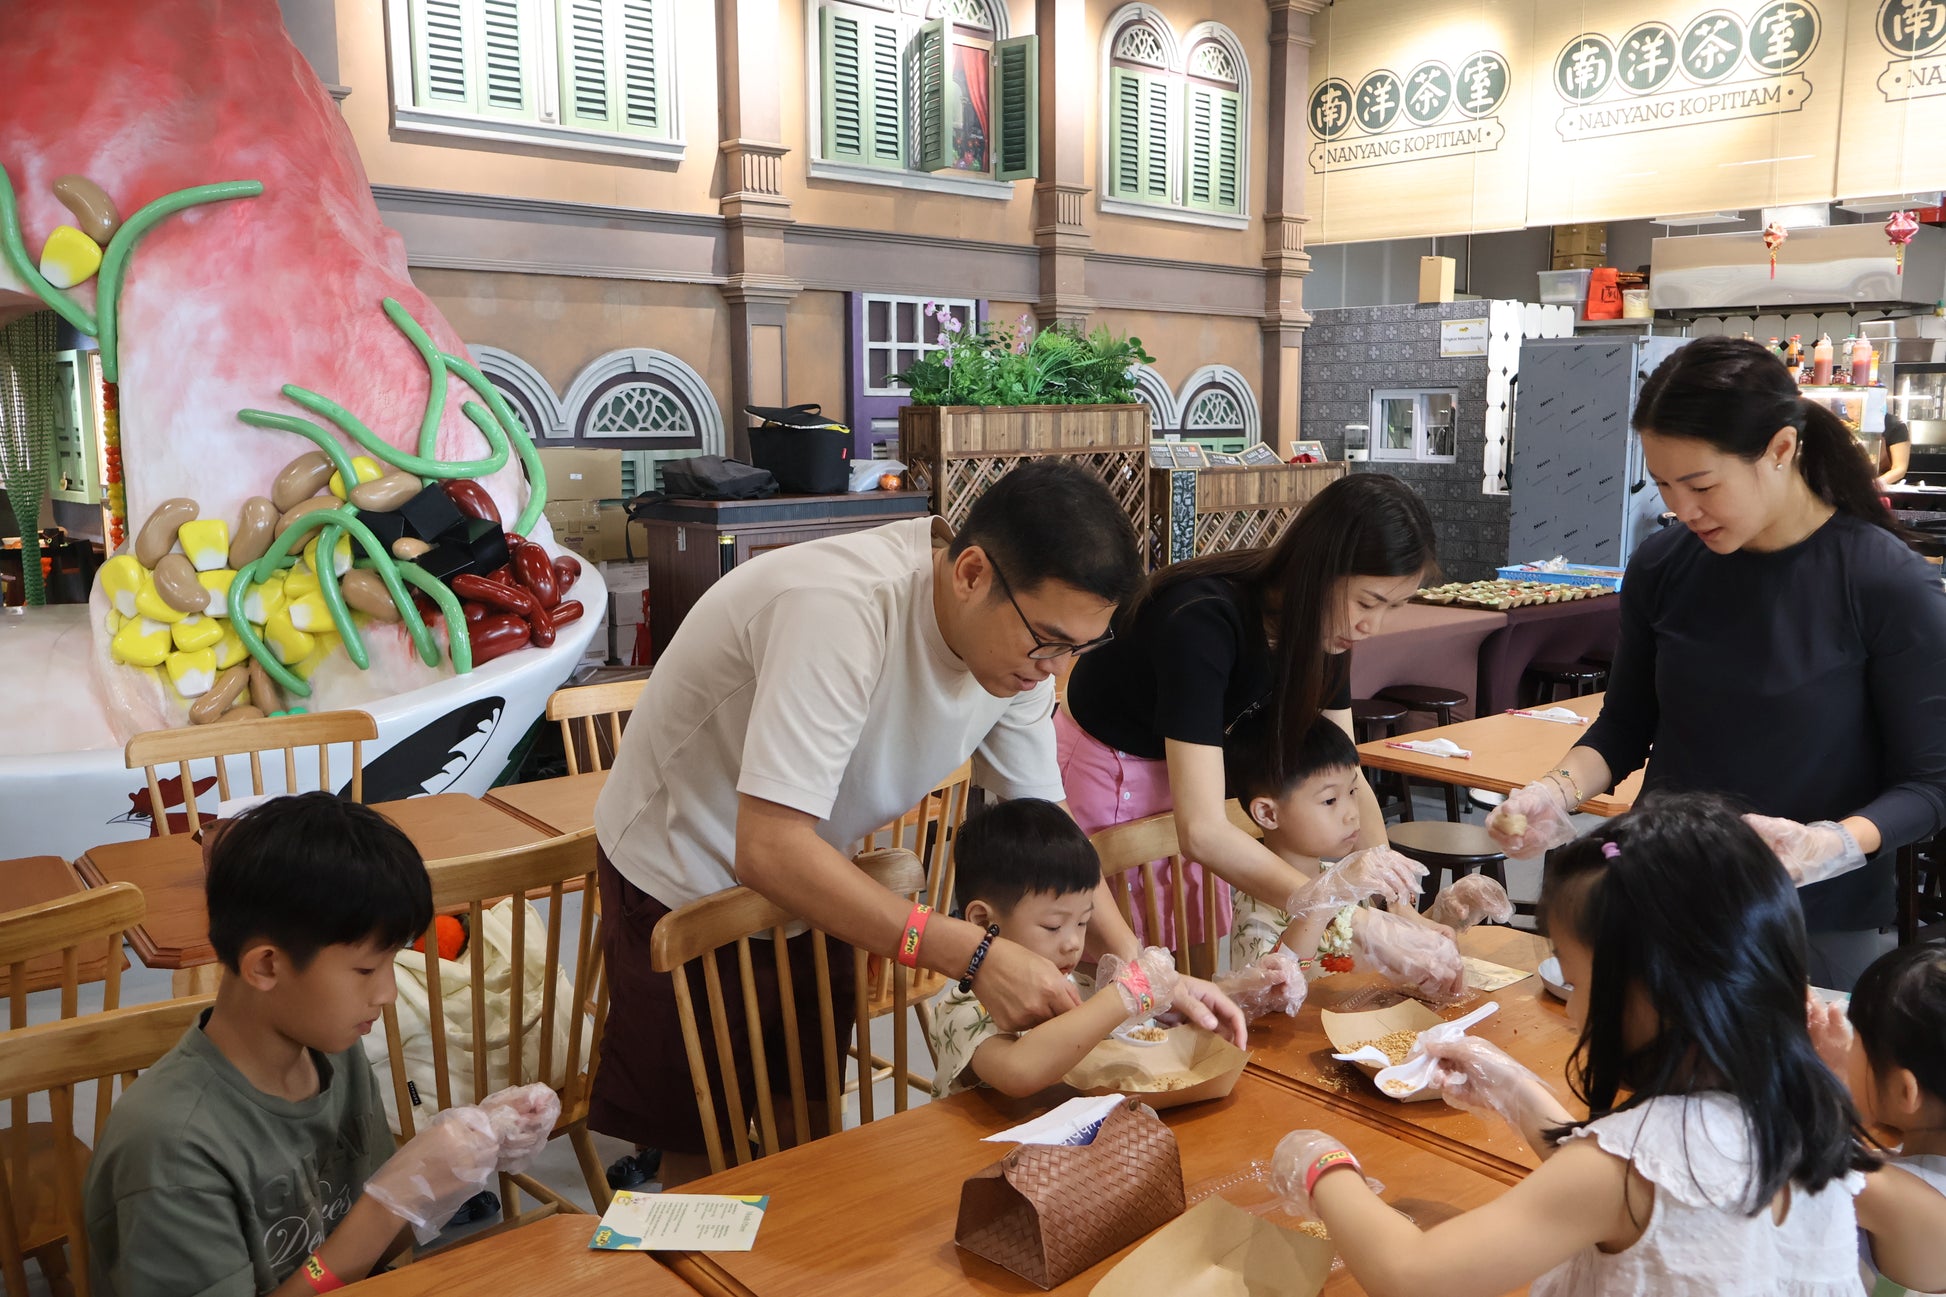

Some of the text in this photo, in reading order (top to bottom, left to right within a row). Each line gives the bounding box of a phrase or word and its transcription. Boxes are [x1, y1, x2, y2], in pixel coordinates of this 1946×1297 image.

[1566, 9, 1805, 91] 南洋茶室
[1316, 60, 1498, 128] 南洋茶室
[1578, 85, 1781, 131] NANYANG KOPITIAM
[1327, 128, 1482, 164] NANYANG KOPITIAM
